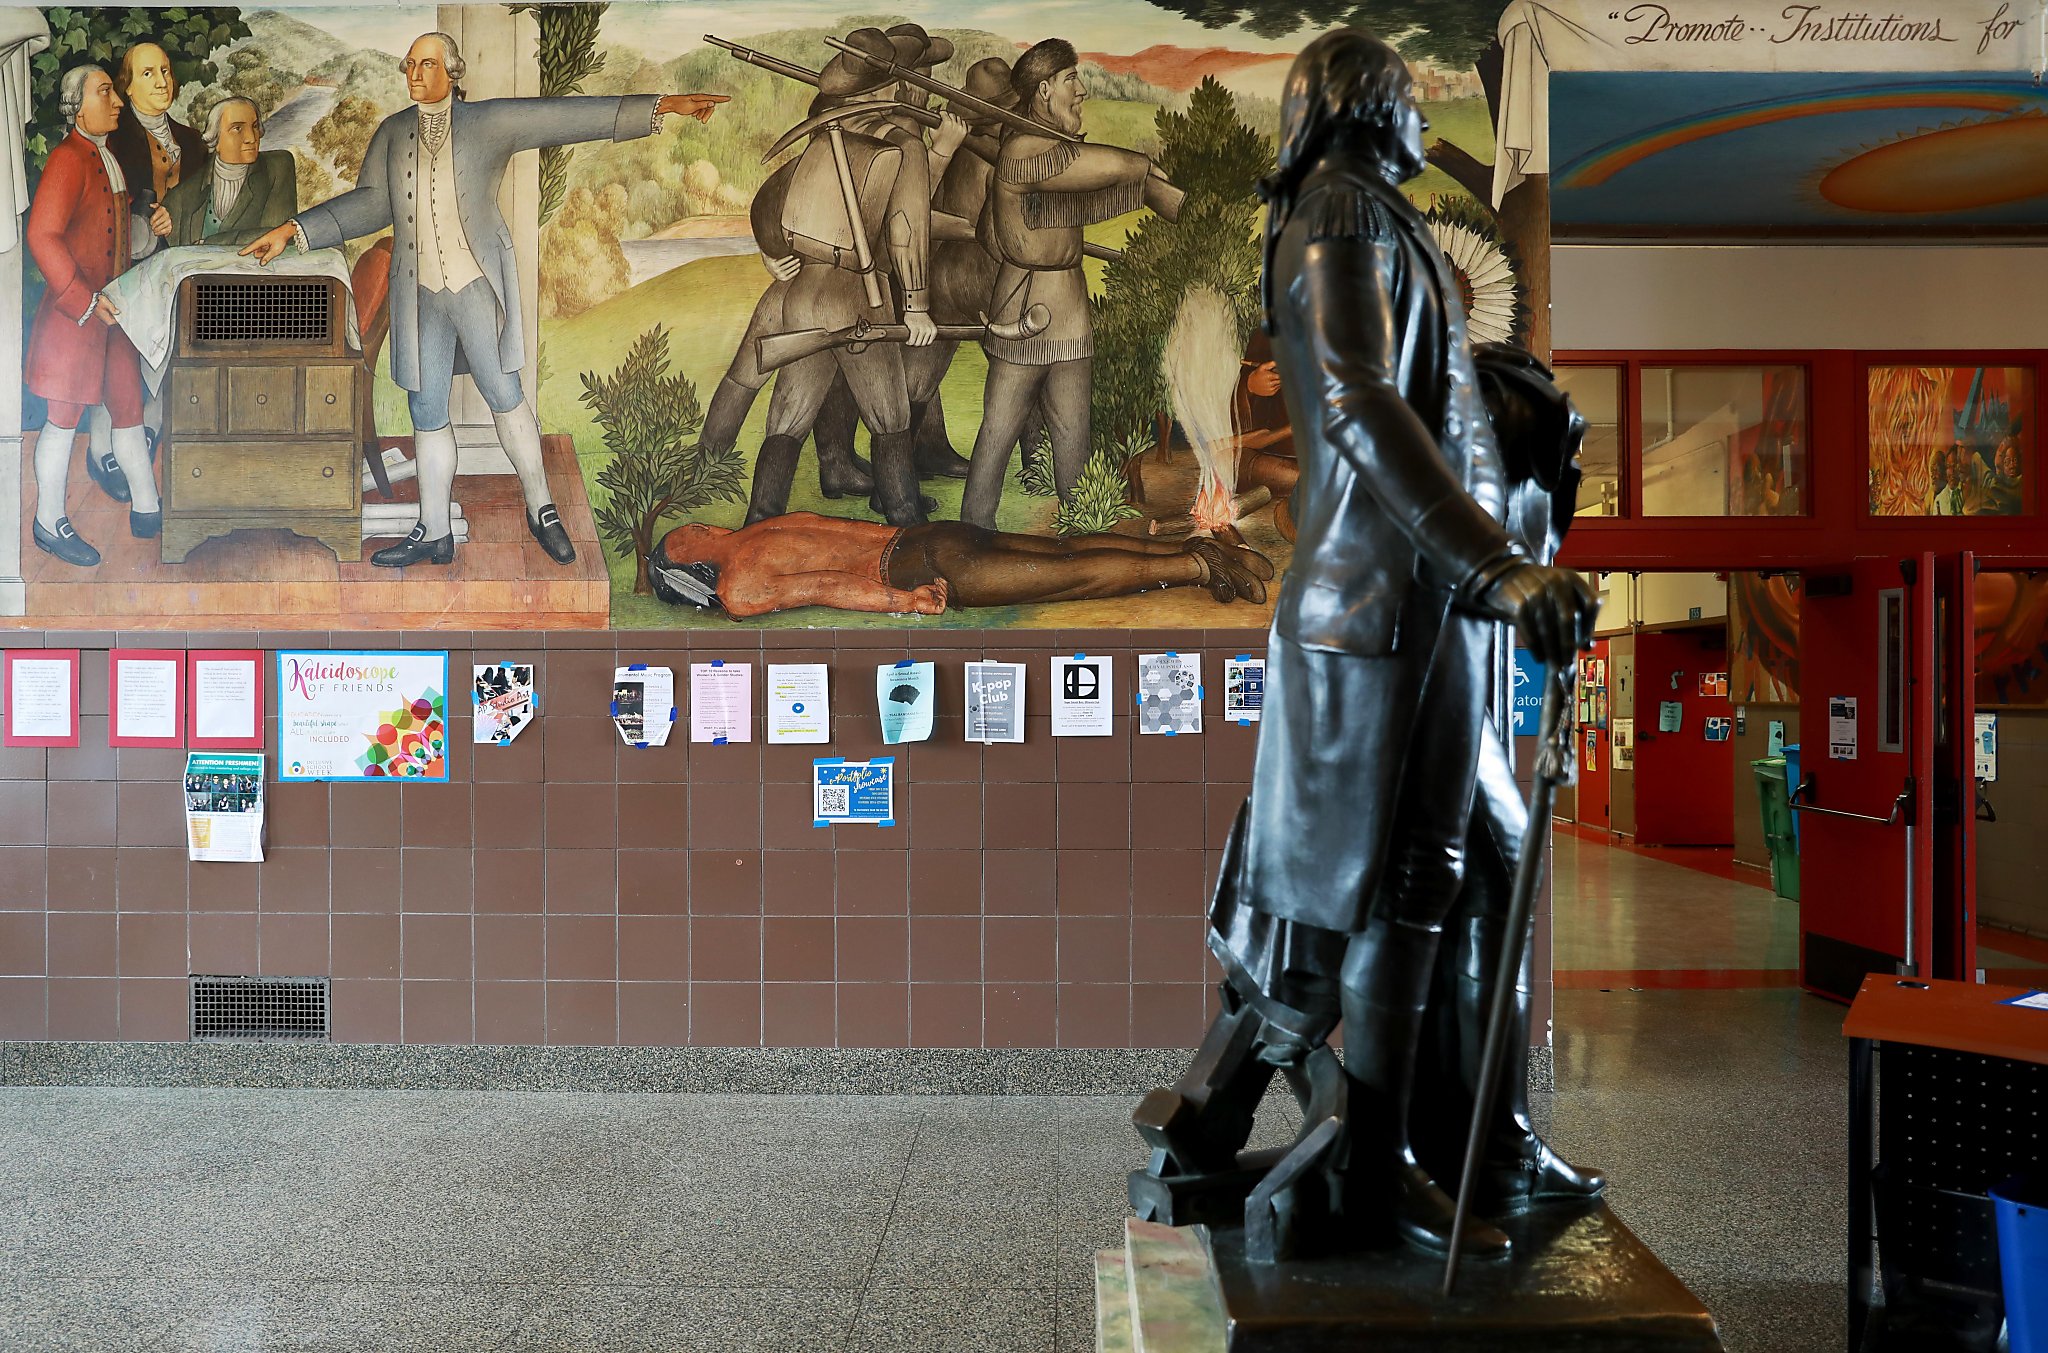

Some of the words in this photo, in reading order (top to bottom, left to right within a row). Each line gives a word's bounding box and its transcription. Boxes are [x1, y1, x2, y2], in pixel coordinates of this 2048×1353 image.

[1768, 4, 1958, 44] Institutions
[1977, 2, 2025, 55] for
[287, 658, 400, 700] Kaleidoscope
[971, 679, 1012, 694] K-pop
[308, 683, 325, 693] OF
[333, 683, 393, 693] FRIENDS
[477, 703, 488, 714] AP
[489, 695, 516, 711] Studio
[516, 689, 530, 700] Art
[980, 690, 1009, 705] Club
[309, 735, 350, 743] INCLUDED
[829, 769, 872, 785] e-Portfolio
[853, 773, 888, 794] showcase
